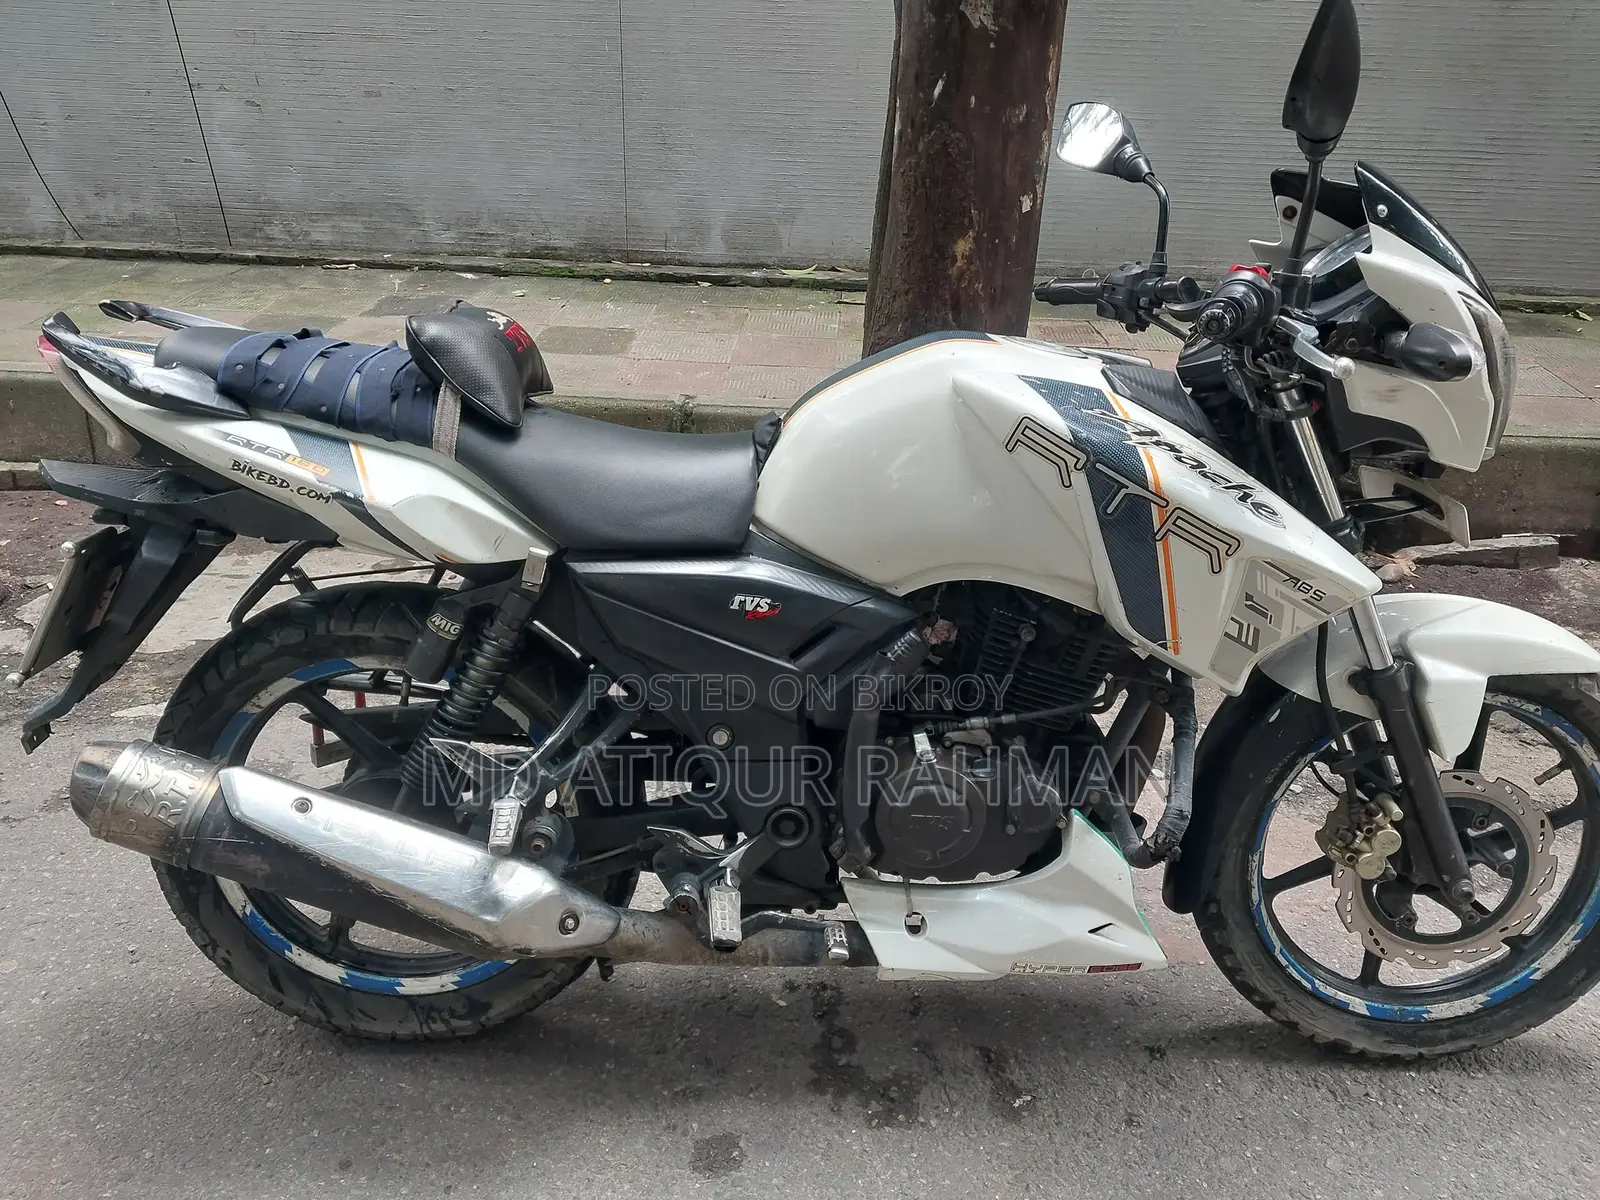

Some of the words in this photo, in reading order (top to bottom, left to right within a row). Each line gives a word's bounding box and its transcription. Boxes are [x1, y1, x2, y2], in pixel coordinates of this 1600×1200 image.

[227, 434, 285, 459] RTR
[1082, 407, 1287, 530] Apache
[1004, 414, 1242, 576] RTR
[1282, 576, 1327, 602] ABS
[729, 594, 772, 613] TVS
[431, 615, 461, 635] MIG
[1010, 962, 1088, 974] HYPER
